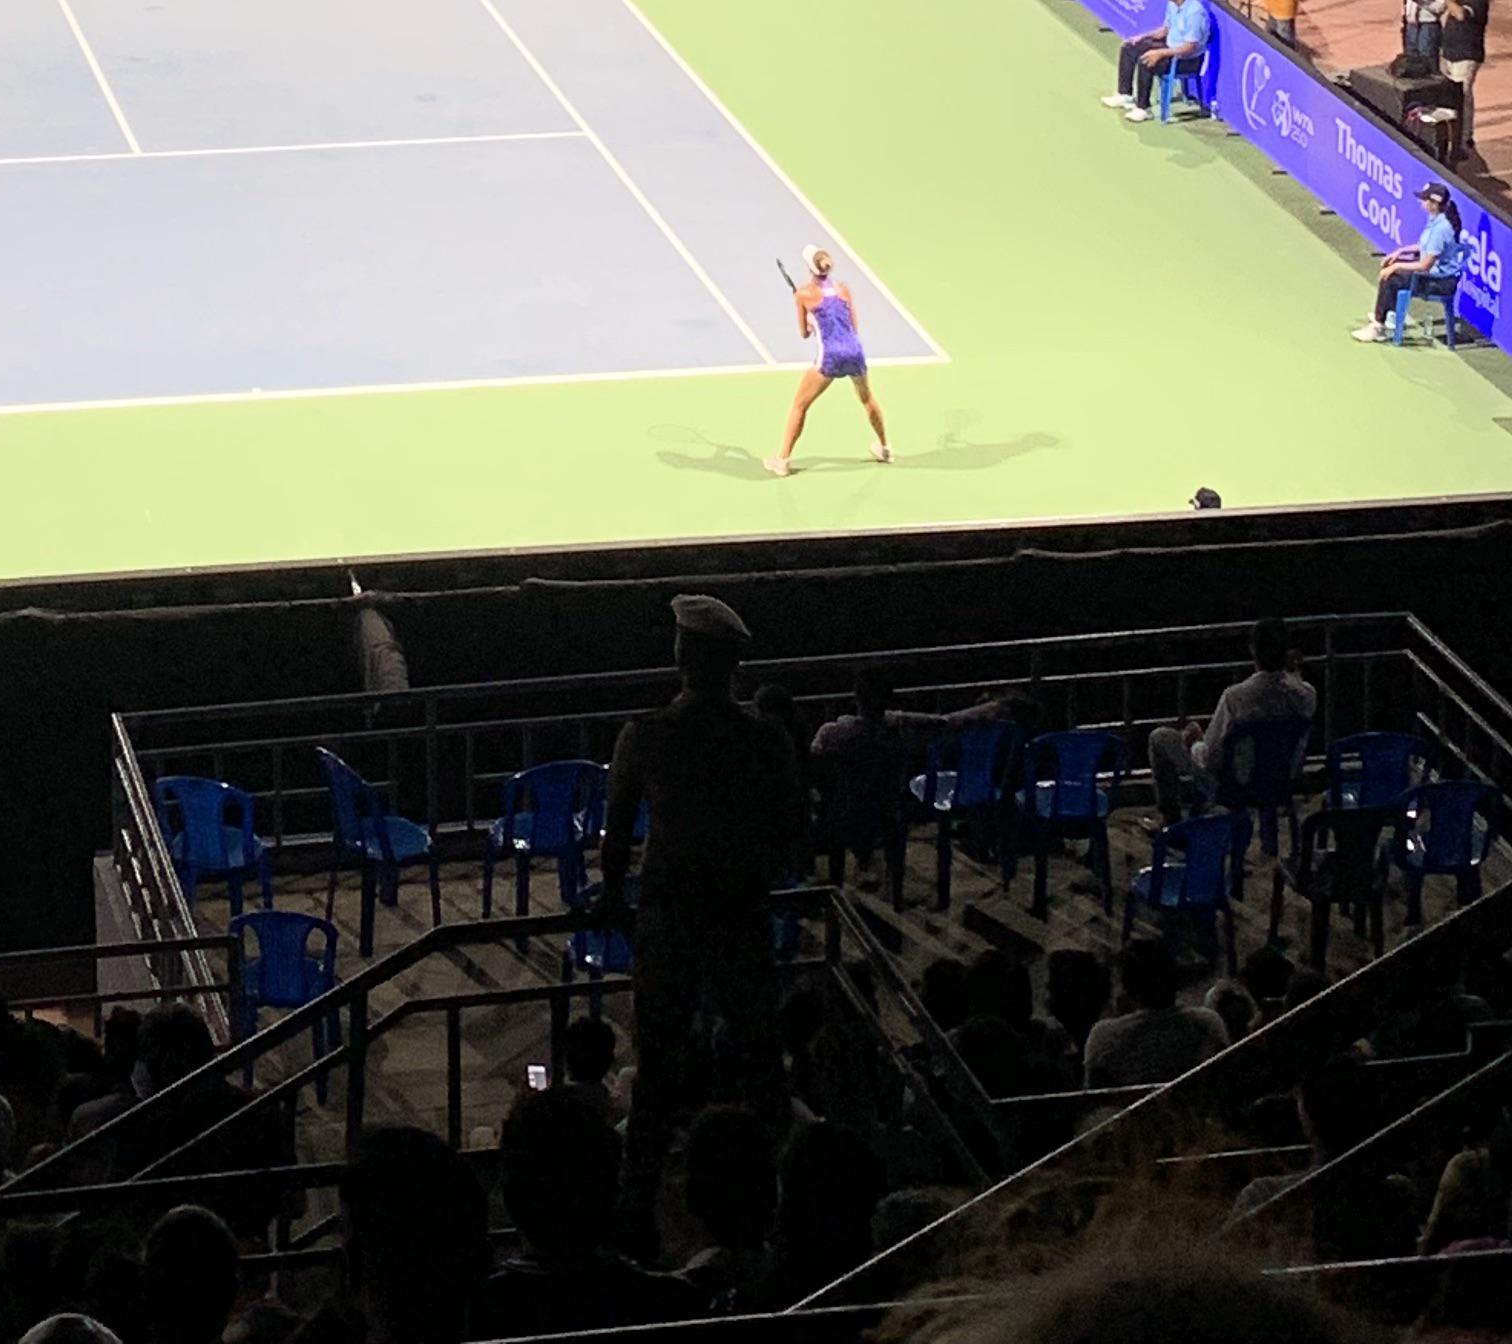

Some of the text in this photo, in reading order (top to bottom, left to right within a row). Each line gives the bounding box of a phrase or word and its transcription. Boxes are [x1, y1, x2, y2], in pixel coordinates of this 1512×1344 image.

[1293, 106, 1315, 137] WTA
[1335, 117, 1403, 200] Thomas
[1357, 181, 1403, 245] Cook
